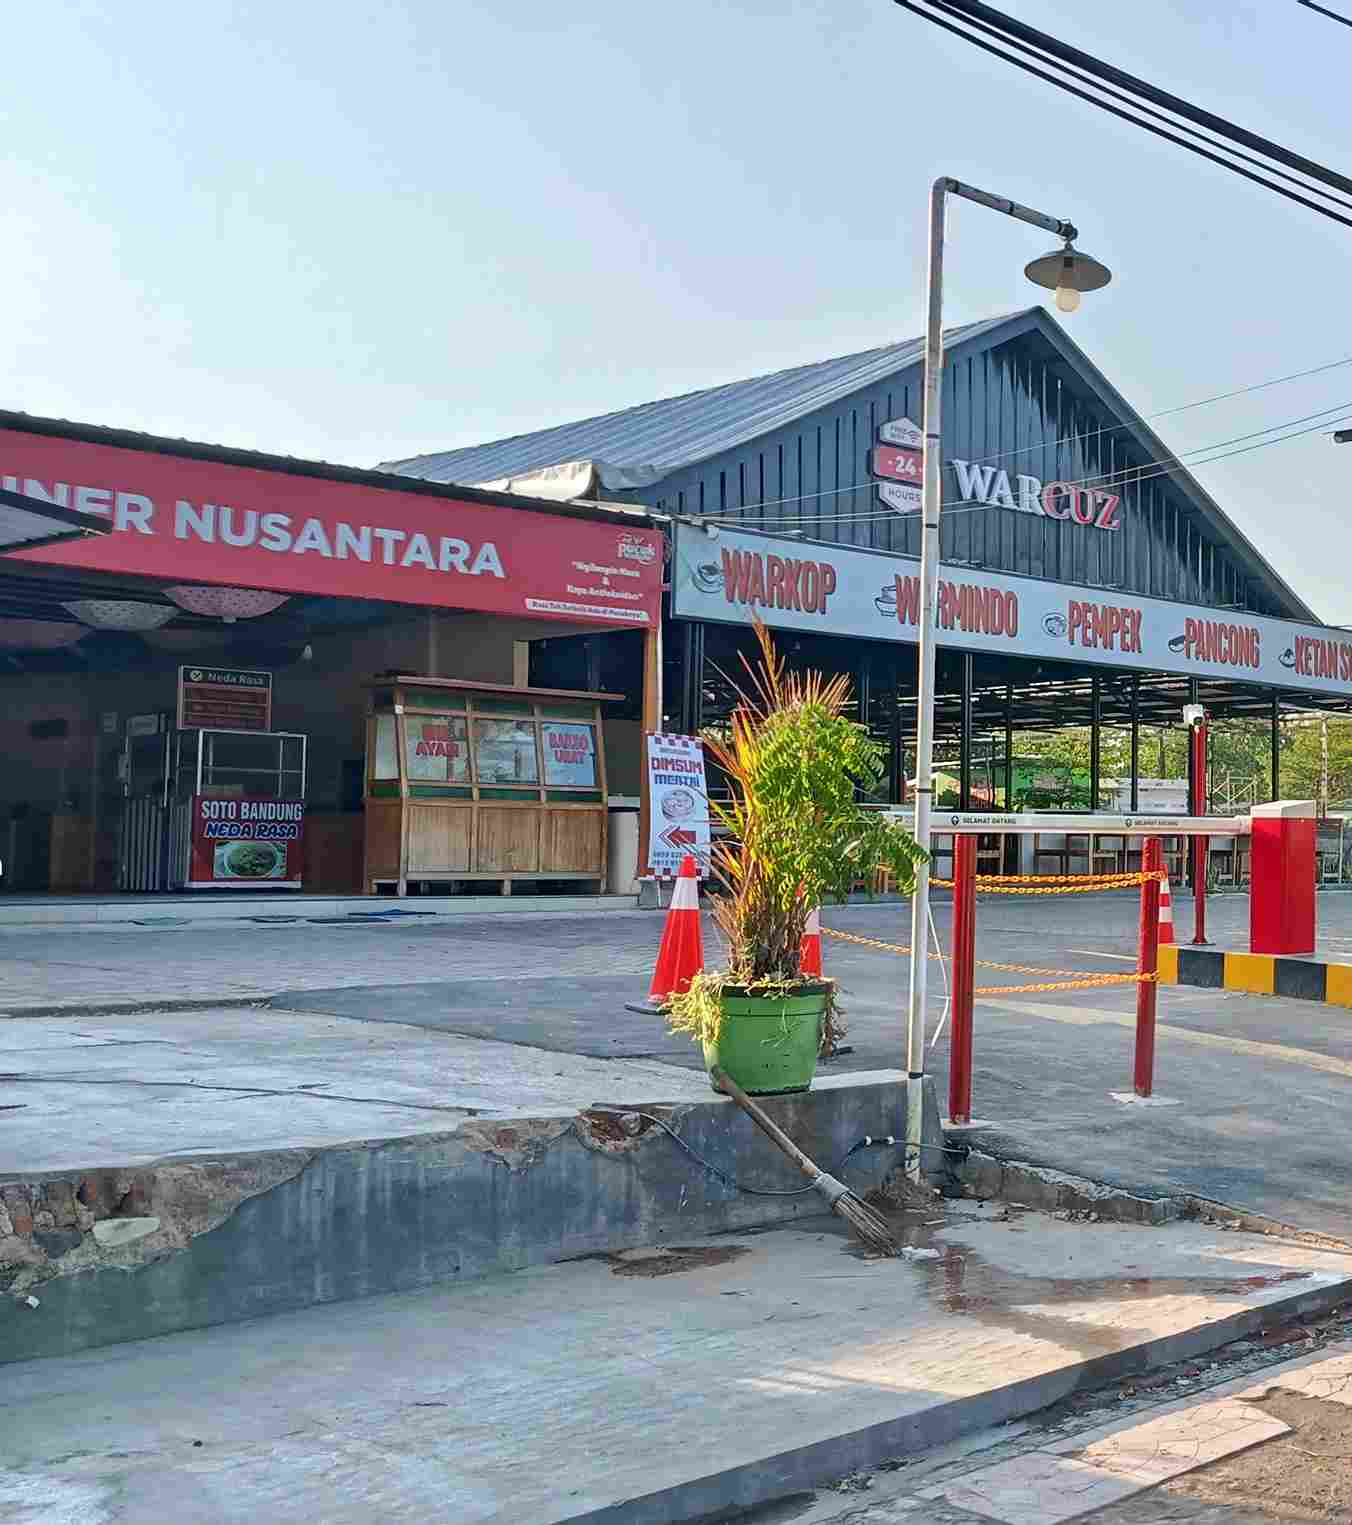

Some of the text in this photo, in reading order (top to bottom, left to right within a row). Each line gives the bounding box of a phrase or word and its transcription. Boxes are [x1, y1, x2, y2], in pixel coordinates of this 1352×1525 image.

[895, 456, 917, 476] 24
[951, 459, 1121, 531] WARCUZ
[174, 500, 505, 579] NUSANTARA
[721, 547, 837, 615] WARKOP
[894, 573, 1018, 638] WRMINDO
[1068, 599, 1143, 653] PEMPEK
[1183, 617, 1261, 669] PANCONG
[1295, 634, 1338, 681] KETAN
[208, 671, 265, 686] Neda Rasa
[651, 757, 703, 775] DIMSUM
[201, 800, 303, 821] SOTO BANDUNG
[204, 822, 298, 839] NEDA RASA
